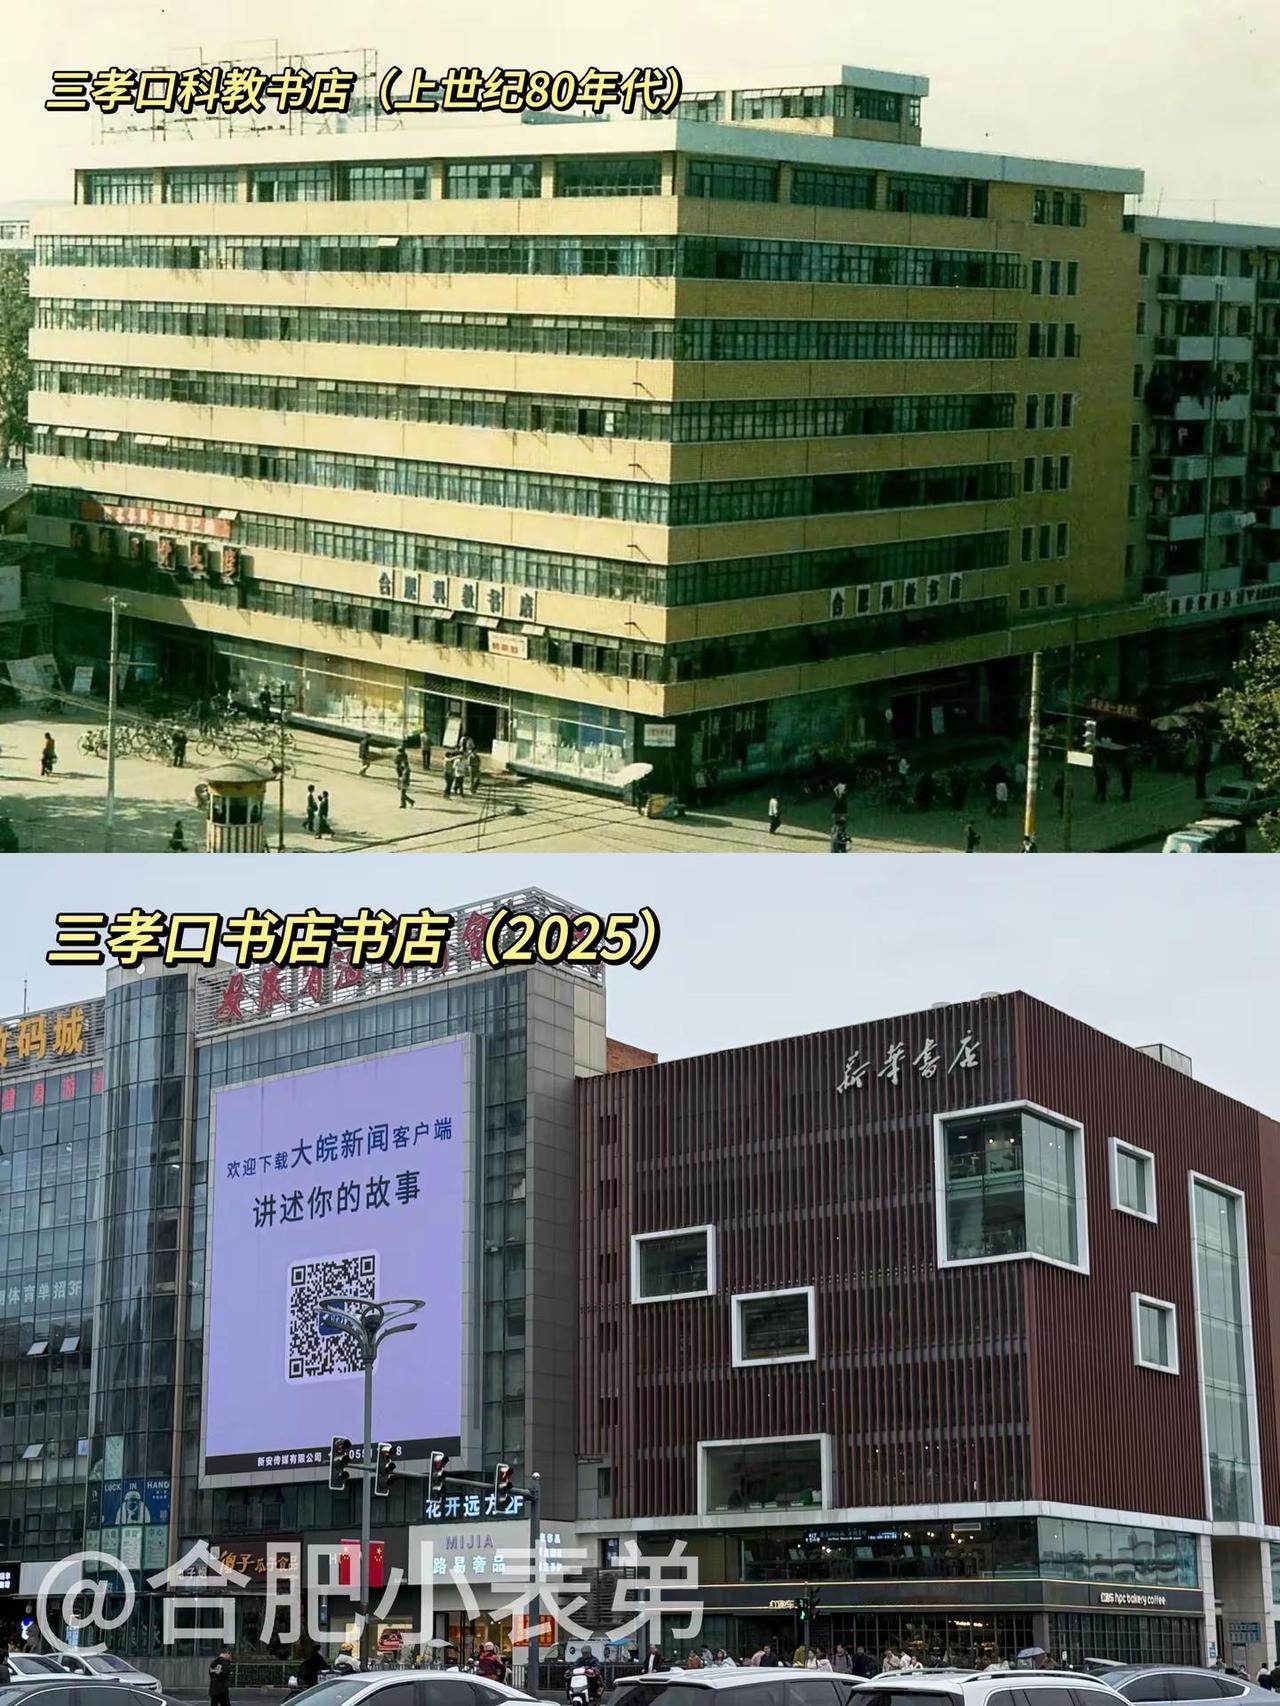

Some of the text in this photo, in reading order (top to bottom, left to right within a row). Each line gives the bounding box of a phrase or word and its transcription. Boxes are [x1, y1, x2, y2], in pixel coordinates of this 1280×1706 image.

[0, 1007, 84, 1067] 码城
[226, 1117, 452, 1180] 欢迎下载大皖新闻客户端
[252, 1169, 421, 1229] 讲述你的故事
[257, 1452, 322, 1467] 新安传媒有限公司
[129, 1482, 137, 1490] IN
[147, 1481, 169, 1489] HAND
[445, 1534, 494, 1550] MIJIA
[433, 1556, 506, 1575] 路易奢品
[1126, 1593, 1147, 1606] bakery
[1147, 1595, 1167, 1606] coffee
